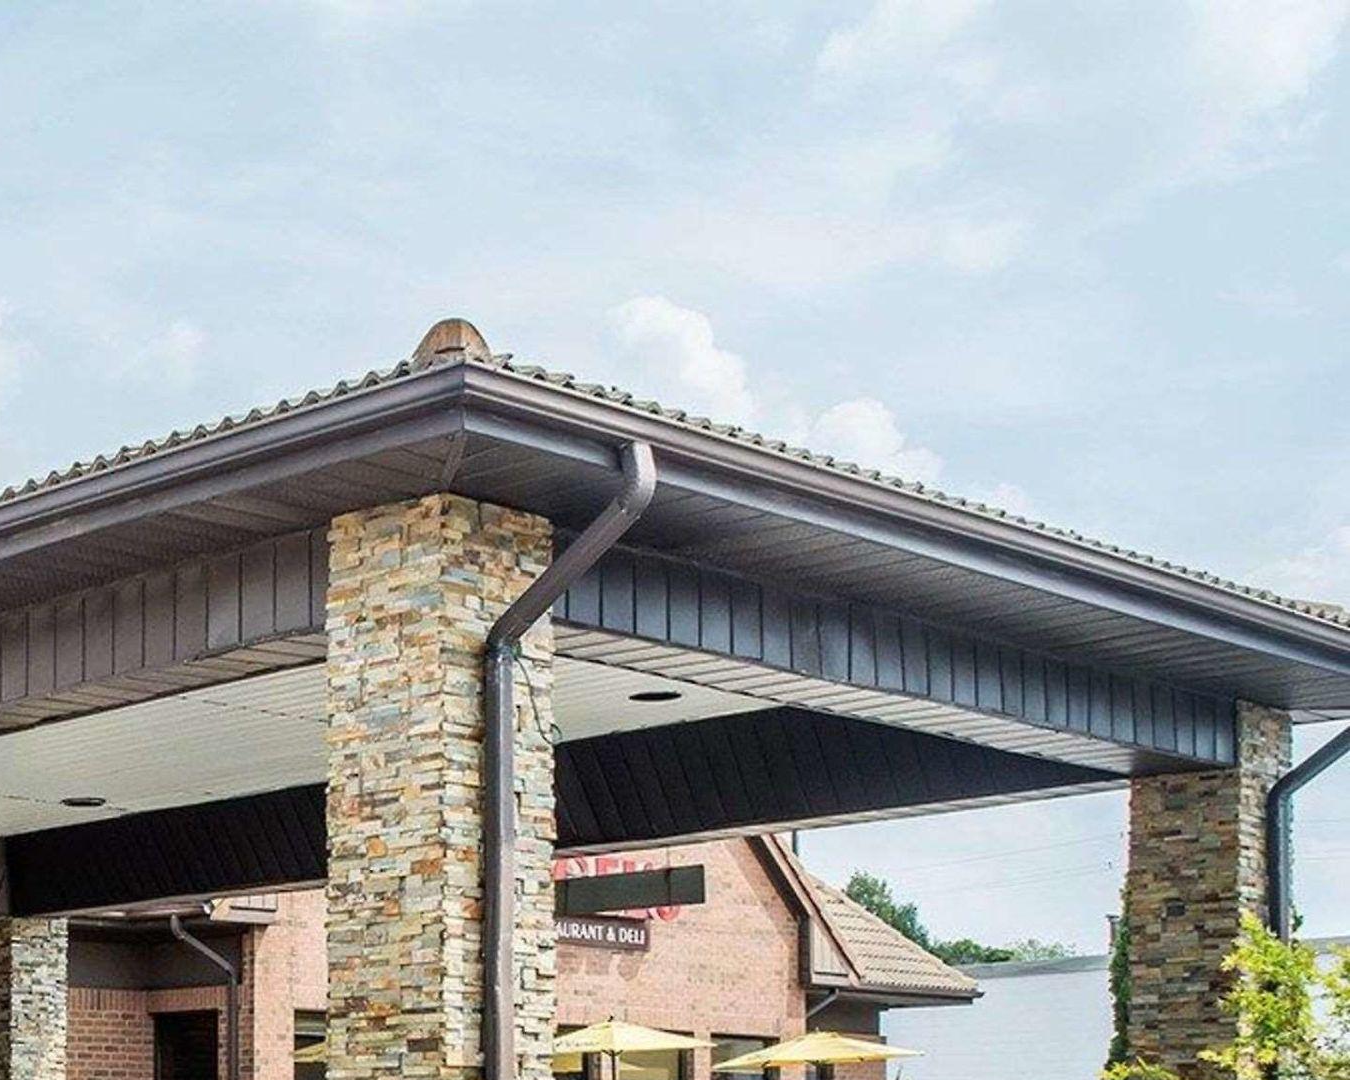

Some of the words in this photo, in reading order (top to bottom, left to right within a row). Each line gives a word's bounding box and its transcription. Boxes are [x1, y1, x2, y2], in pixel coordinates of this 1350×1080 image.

[554, 921, 603, 941] AURANT
[606, 926, 617, 942] &
[618, 928, 646, 945] DELI
